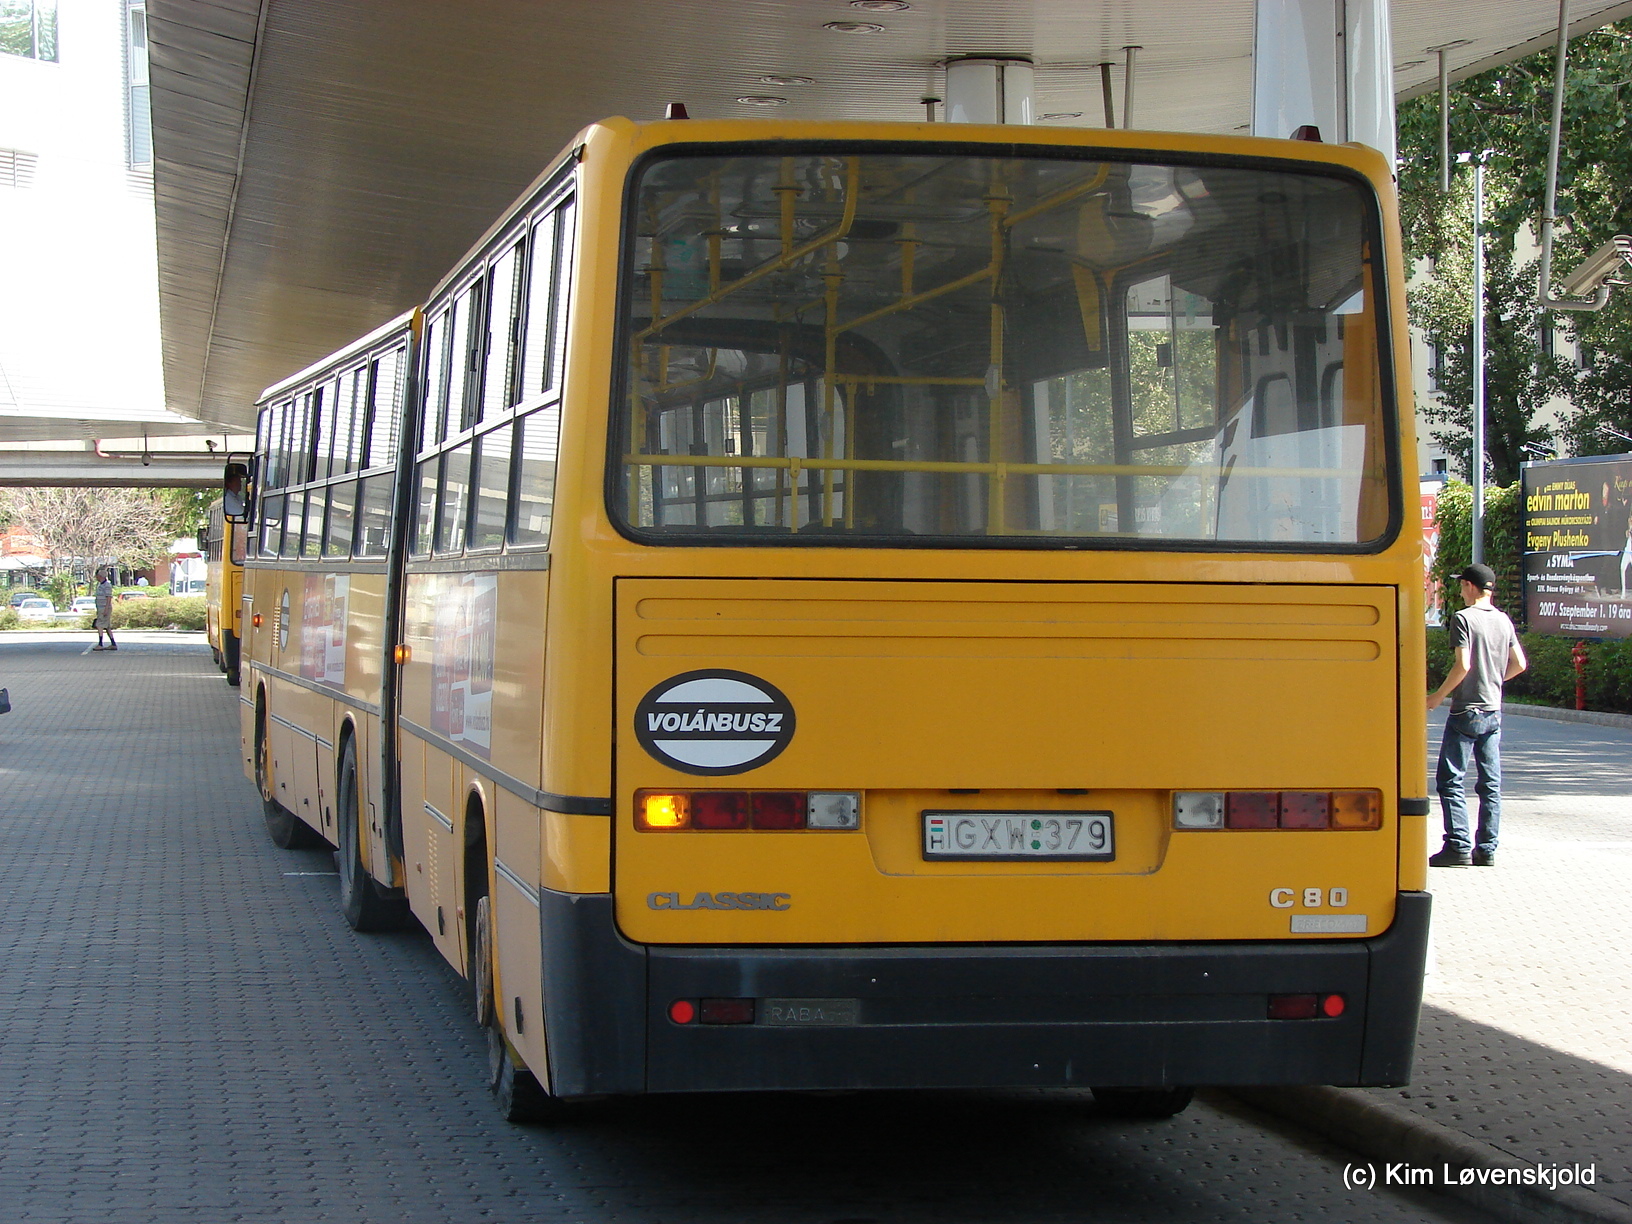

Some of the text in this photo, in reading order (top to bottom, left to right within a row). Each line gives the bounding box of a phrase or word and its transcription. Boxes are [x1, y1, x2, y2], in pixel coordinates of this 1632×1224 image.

[1526, 486, 1590, 512] edvin marton
[1527, 529, 1589, 551] Evgeny Plushenko
[1539, 601, 1631, 621] 2007. Szeptember 1. 19 óra
[648, 709, 784, 732] VOLÁNBUSZ
[646, 891, 791, 911] CLASSIC
